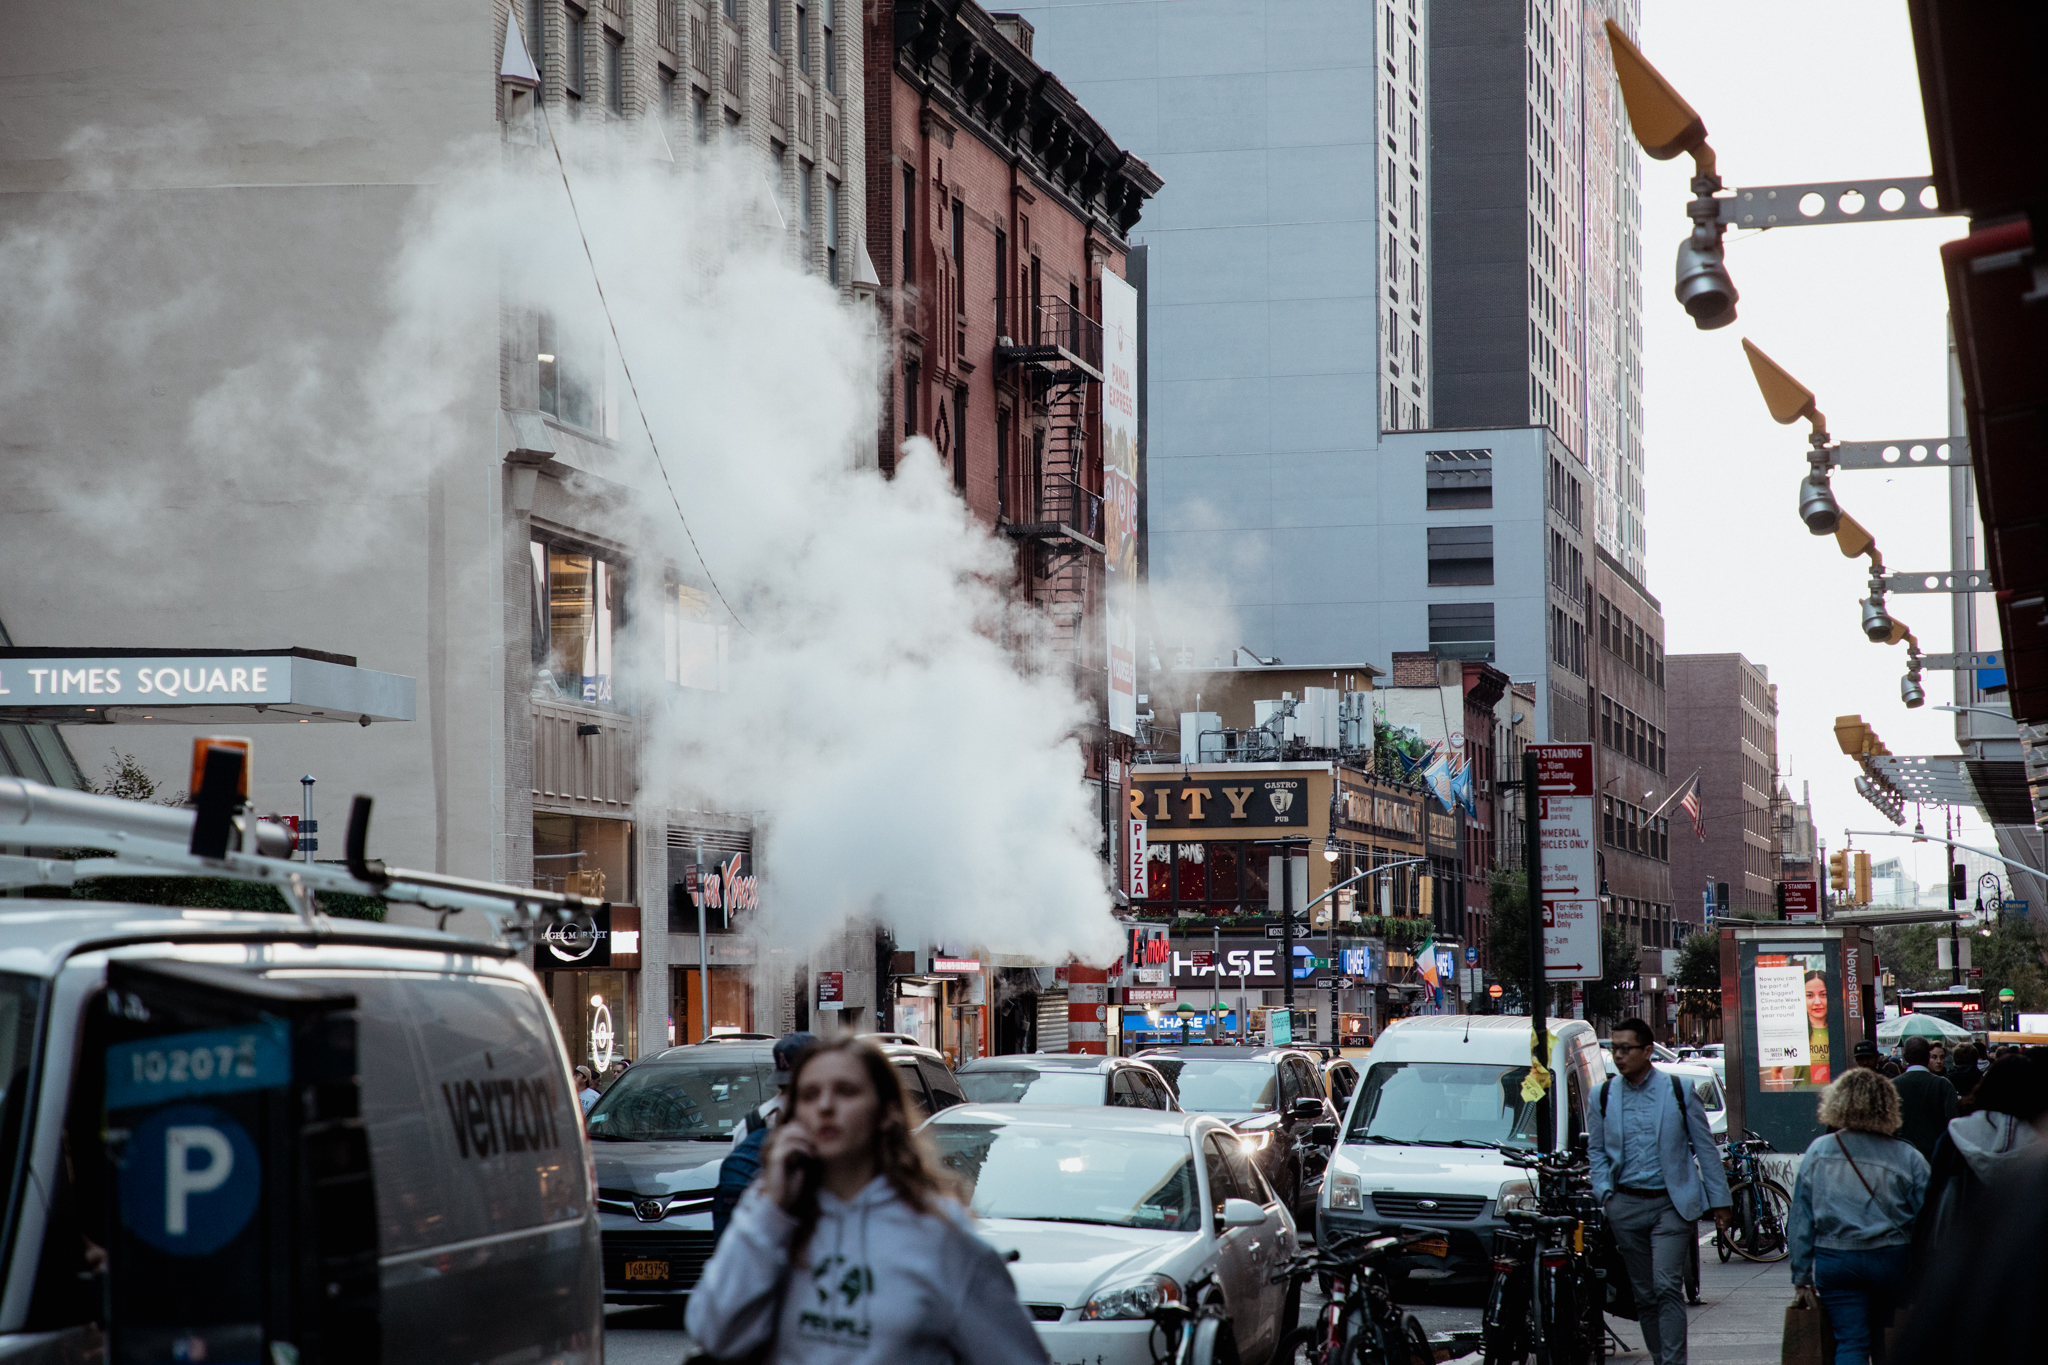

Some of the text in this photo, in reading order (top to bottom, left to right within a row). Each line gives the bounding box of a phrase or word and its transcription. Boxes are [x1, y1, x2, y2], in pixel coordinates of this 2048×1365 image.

[1112, 362, 1129, 392] PANDA
[1109, 384, 1132, 417] EXPRESS
[27, 668, 121, 694] TIMES
[137, 667, 268, 697] SQUARE
[1542, 749, 1583, 758] STANDING
[1547, 761, 1564, 769] 10am
[1551, 771, 1574, 780] Sunday
[1264, 781, 1298, 789] GASTRO
[1550, 813, 1571, 821] parking
[1540, 828, 1581, 838] MMERCIAL
[1541, 840, 1589, 849] HICLES ONLY
[1133, 823, 1145, 894] PIZZA
[1554, 863, 1568, 872] 6pm
[1554, 873, 1578, 882] Sunday
[1556, 903, 1583, 911] For-Hire
[1556, 912, 1583, 920] Vehicles
[1556, 921, 1571, 929] Only
[568, 931, 607, 940] MRKET
[1554, 936, 1569, 944] 3am
[1169, 950, 1277, 977] HASE
[1846, 948, 1860, 1019] Newsstand
[1153, 1017, 1203, 1028] CHASE
[1349, 1037, 1365, 1045] 3H21
[1783, 1047, 1798, 1058] NYC
[441, 1052, 560, 1160] verizon
[165, 1126, 234, 1236] P
